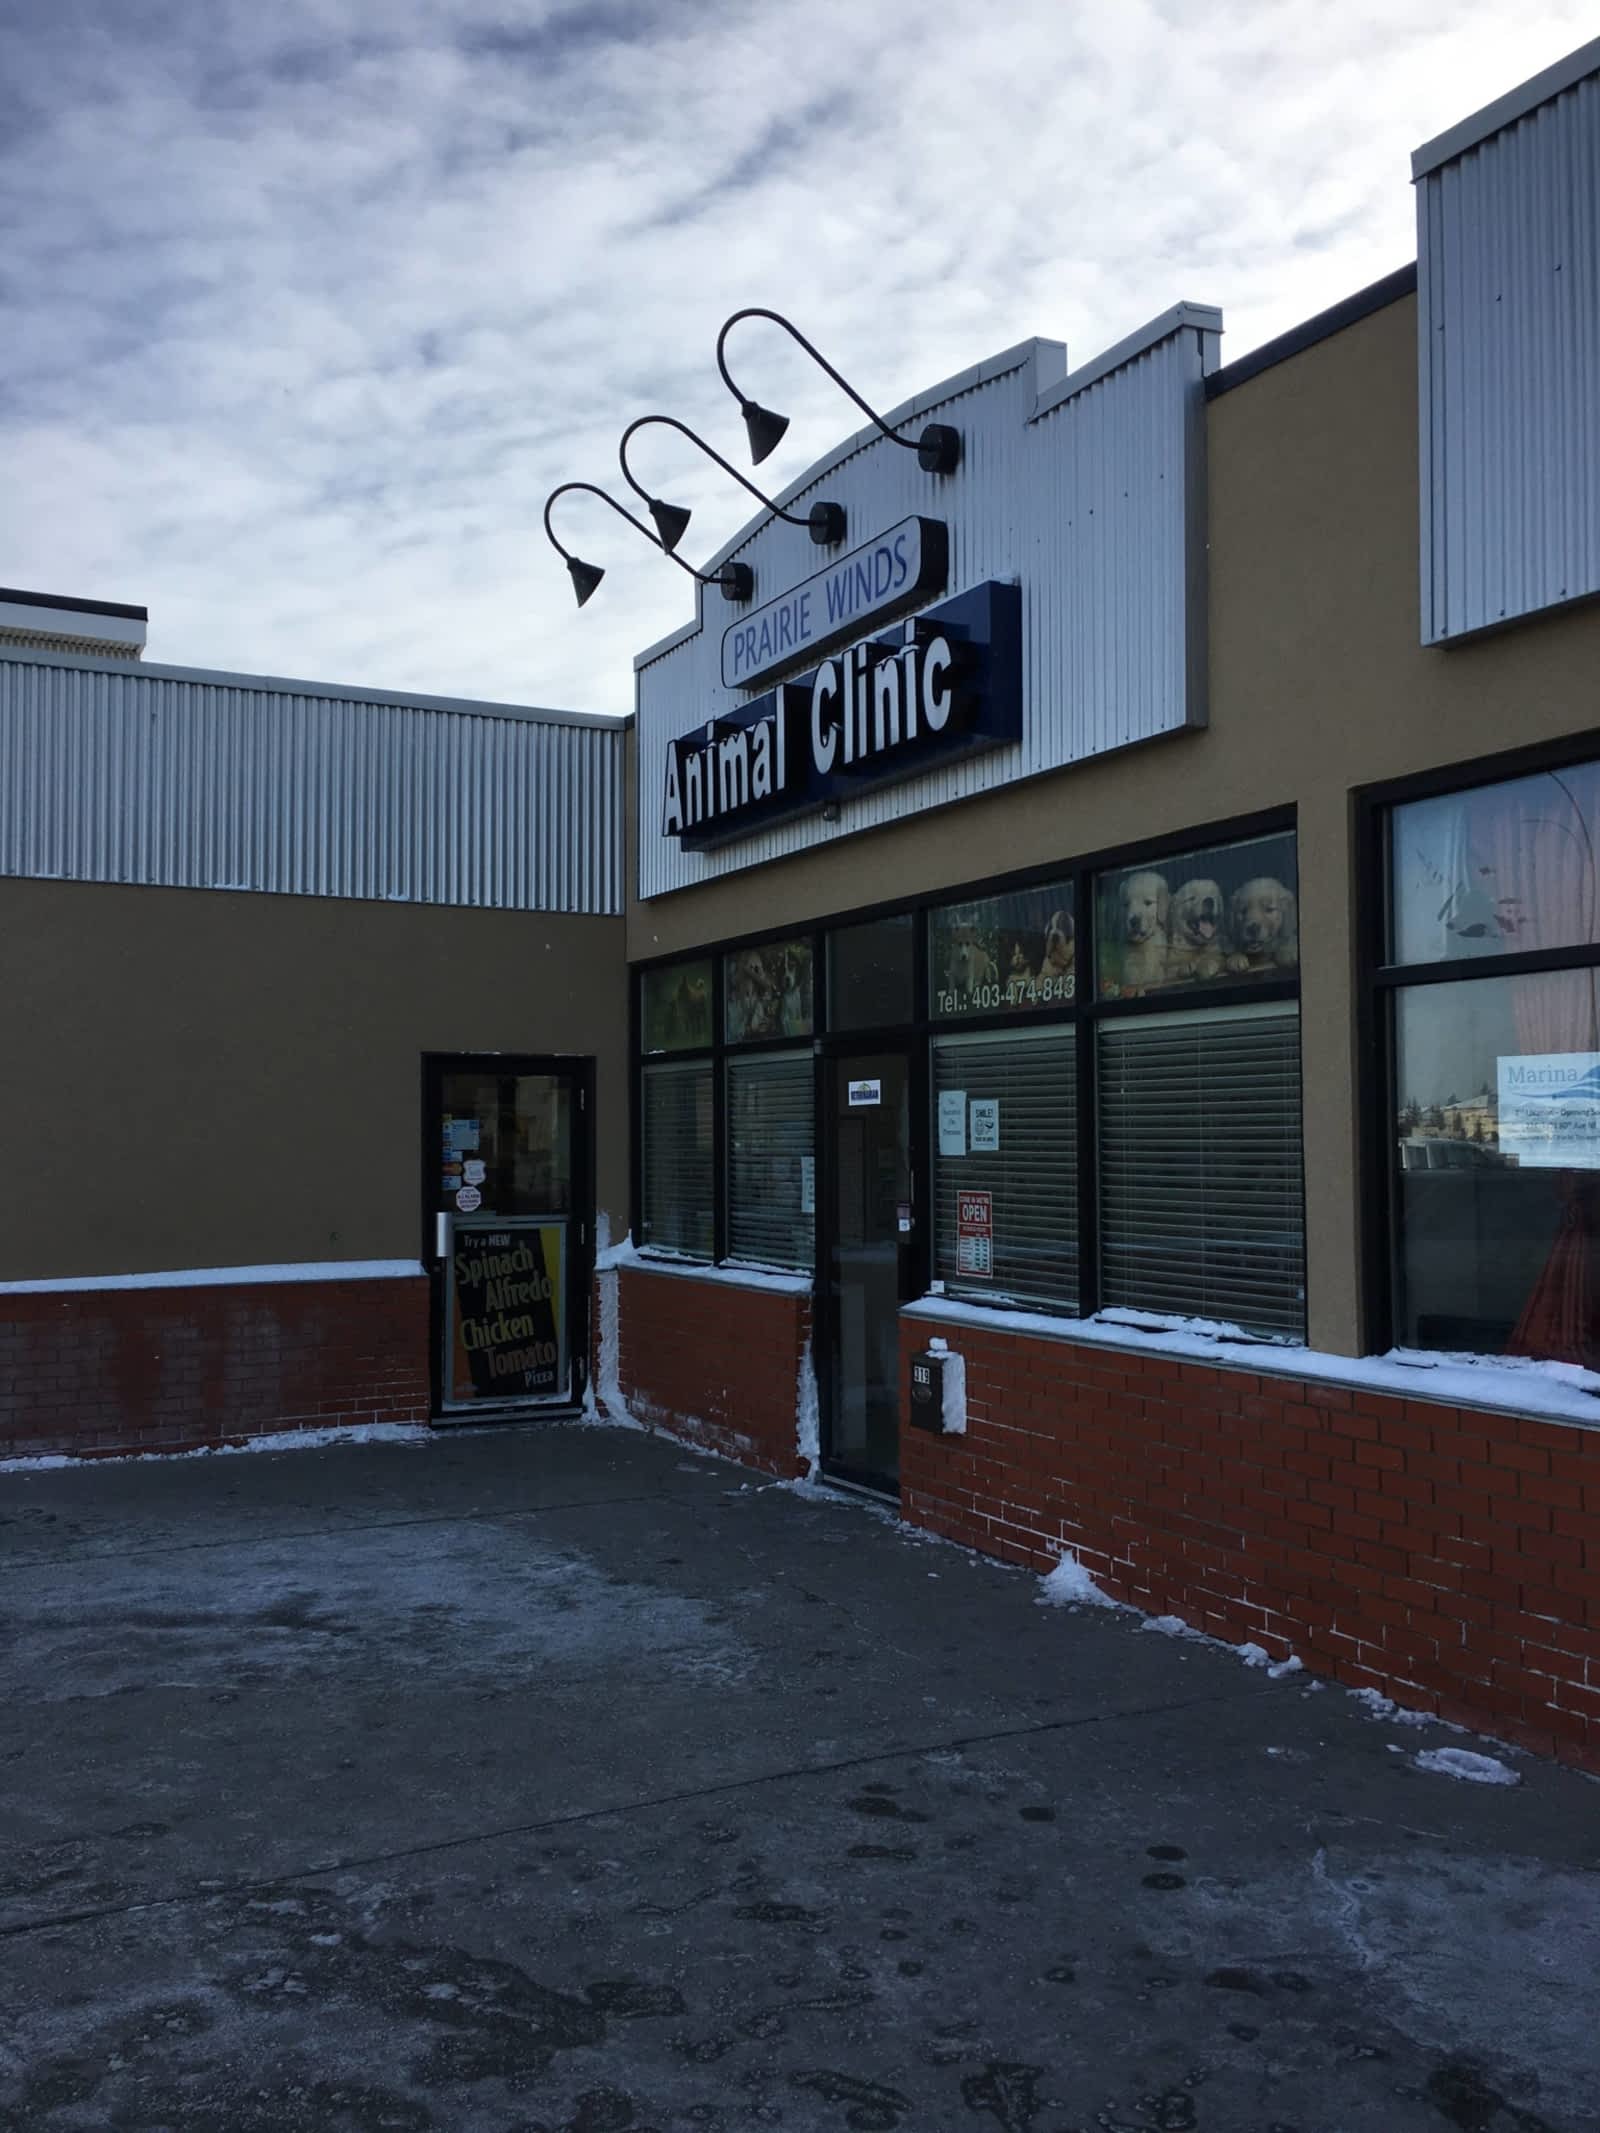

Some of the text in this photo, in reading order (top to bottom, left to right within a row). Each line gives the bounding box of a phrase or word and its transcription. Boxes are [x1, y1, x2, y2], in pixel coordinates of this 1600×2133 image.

[733, 534, 908, 677] PRAIRIE WINDS
[662, 616, 952, 837] Animal Clinic
[1507, 1064, 1577, 1084] Marina
[961, 1203, 988, 1223] OPEN
[463, 1233, 480, 1249] Try
[488, 1233, 511, 1248] NEW
[455, 1240, 535, 1288] Spinach
[486, 1270, 553, 1313] Alfredo
[460, 1312, 535, 1352] Chicken
[482, 1340, 557, 1380] Tomato
[524, 1369, 555, 1388] Pizza
